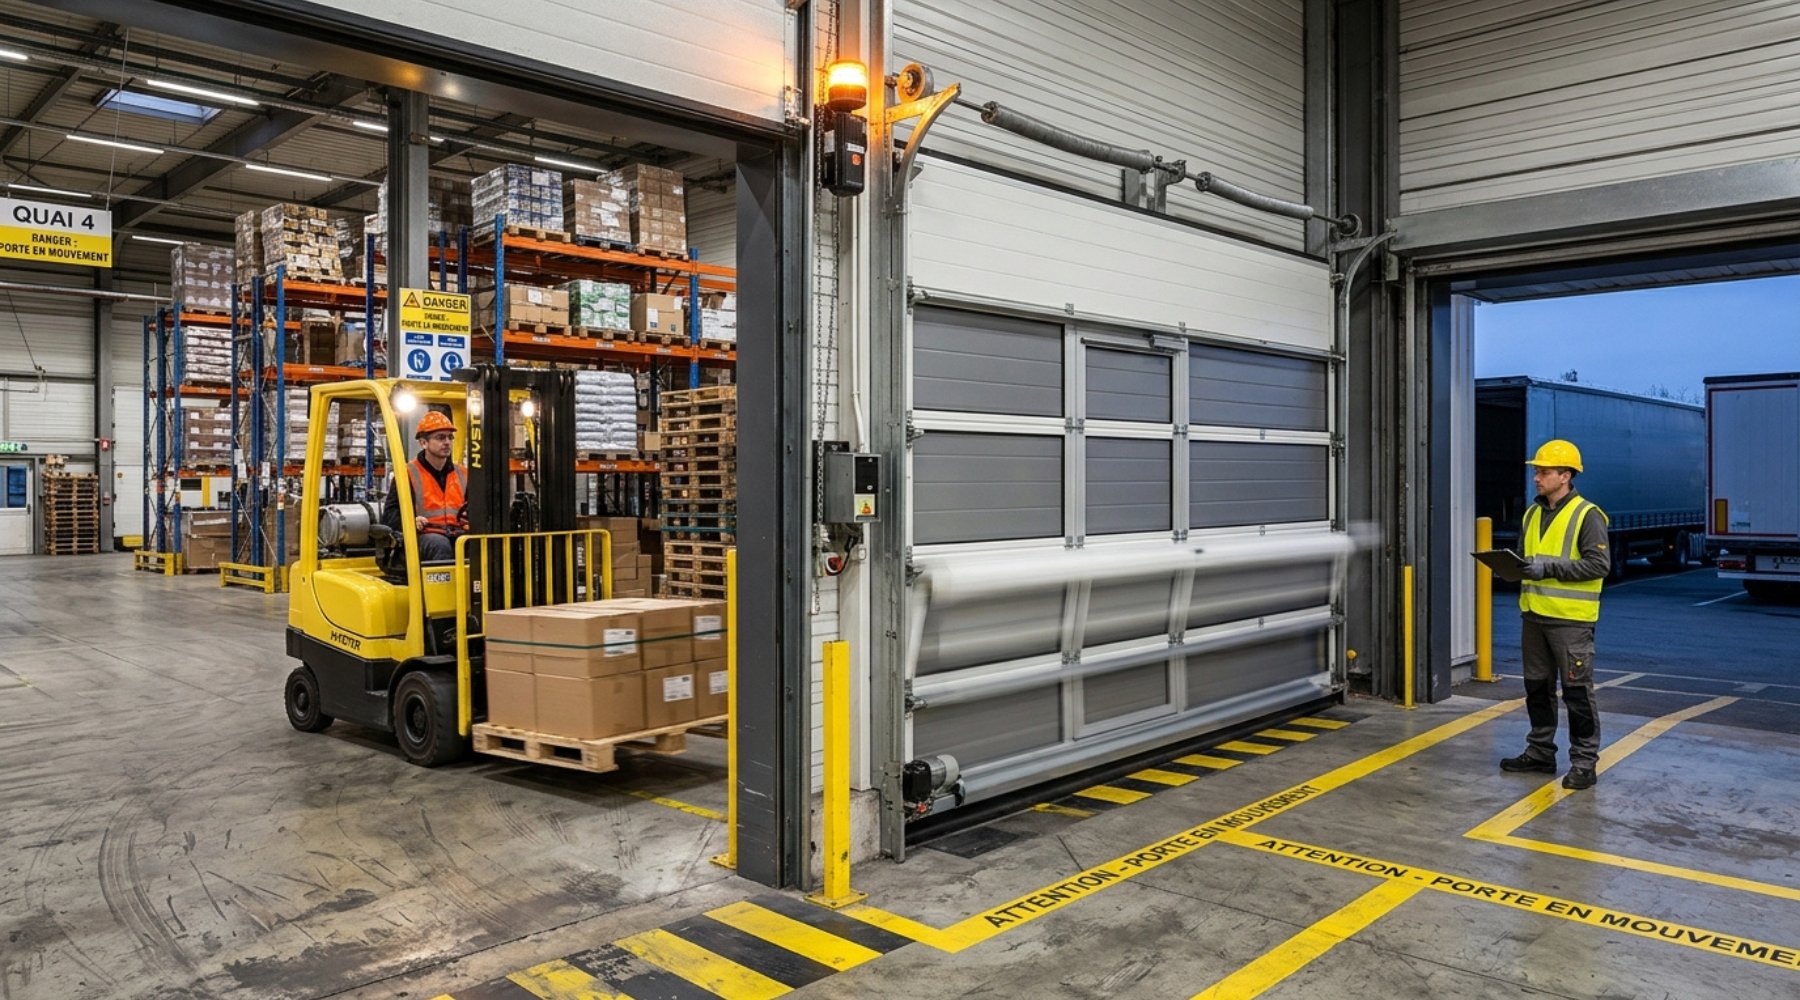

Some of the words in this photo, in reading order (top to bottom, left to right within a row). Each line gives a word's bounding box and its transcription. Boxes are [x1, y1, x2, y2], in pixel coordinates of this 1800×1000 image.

[13, 205, 73, 228] QUAI
[81, 214, 95, 230] 4
[33, 245, 46, 256] EN
[48, 247, 109, 262] MOUVEMENT
[984, 869, 1120, 928] ATTENTION
[1123, 836, 1200, 867] PORTE
[1257, 840, 1409, 878] ATTENTION
[1431, 877, 1539, 907] PORTE
[1545, 901, 1592, 919] EN
[1600, 913, 1800, 966] MOUVEME
